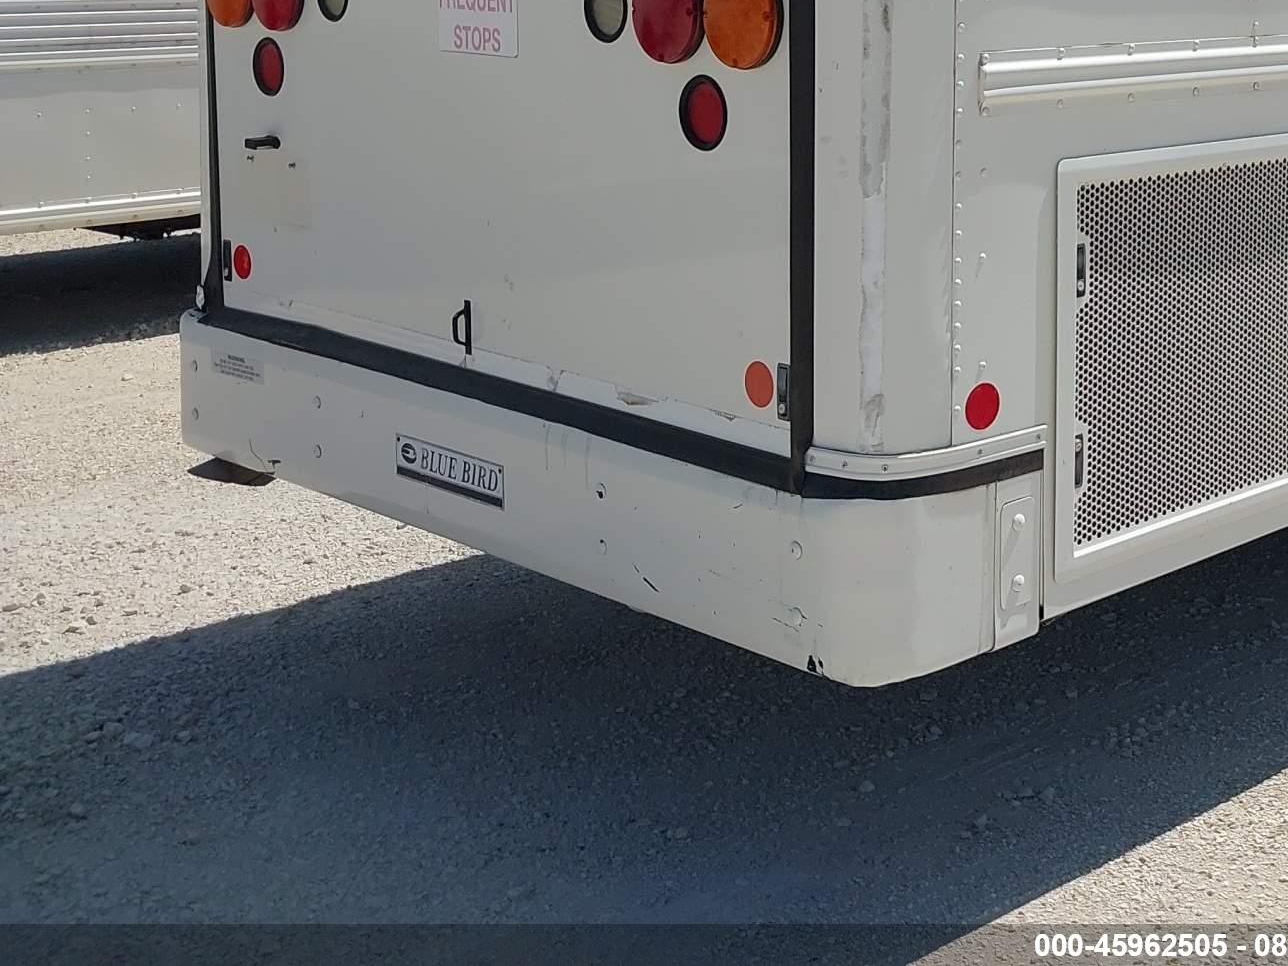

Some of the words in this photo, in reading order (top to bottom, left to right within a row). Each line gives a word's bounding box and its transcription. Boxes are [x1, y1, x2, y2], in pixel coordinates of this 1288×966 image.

[453, 24, 501, 52] STOPS
[420, 447, 458, 480] BLUE
[461, 459, 498, 492] BIRD
